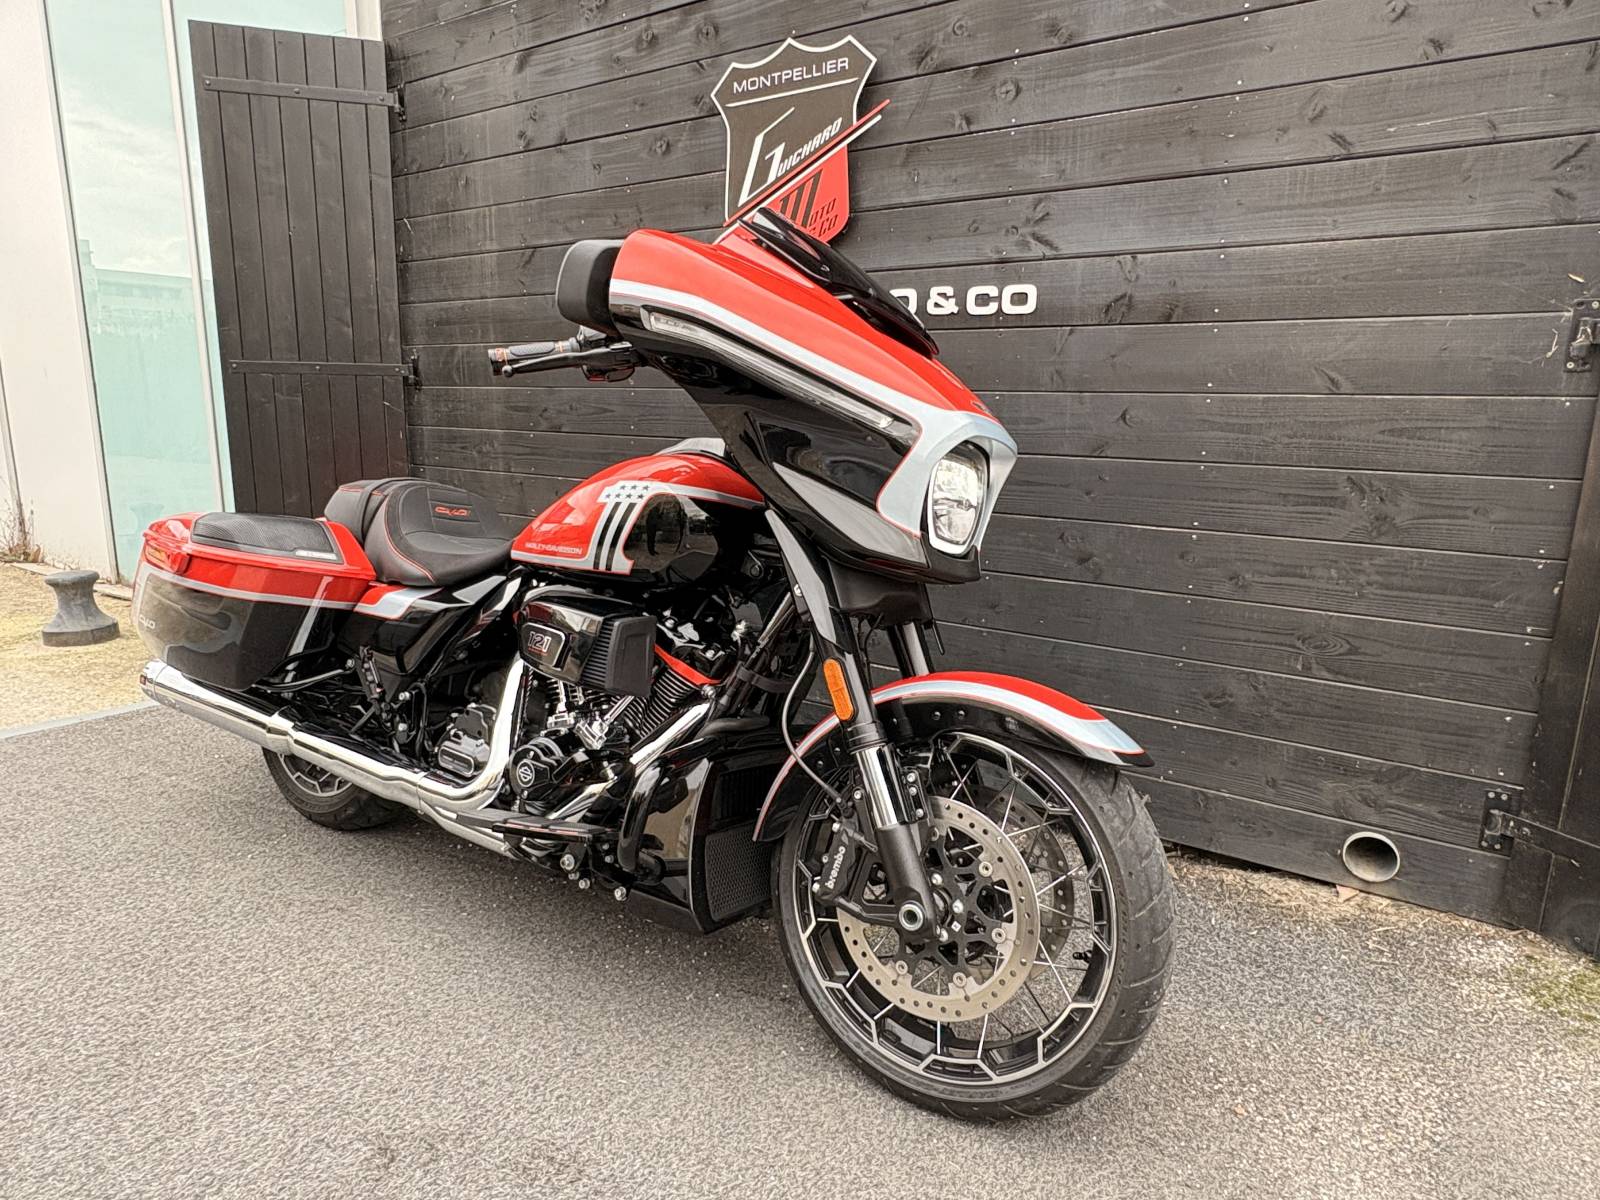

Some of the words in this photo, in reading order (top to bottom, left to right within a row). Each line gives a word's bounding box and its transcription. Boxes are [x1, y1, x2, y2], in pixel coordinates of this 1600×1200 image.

[733, 57, 849, 94] MONTPELLIER
[926, 286, 959, 316] &
[966, 284, 1038, 316] CO
[528, 631, 552, 653] 121
[824, 846, 846, 890] brembo
